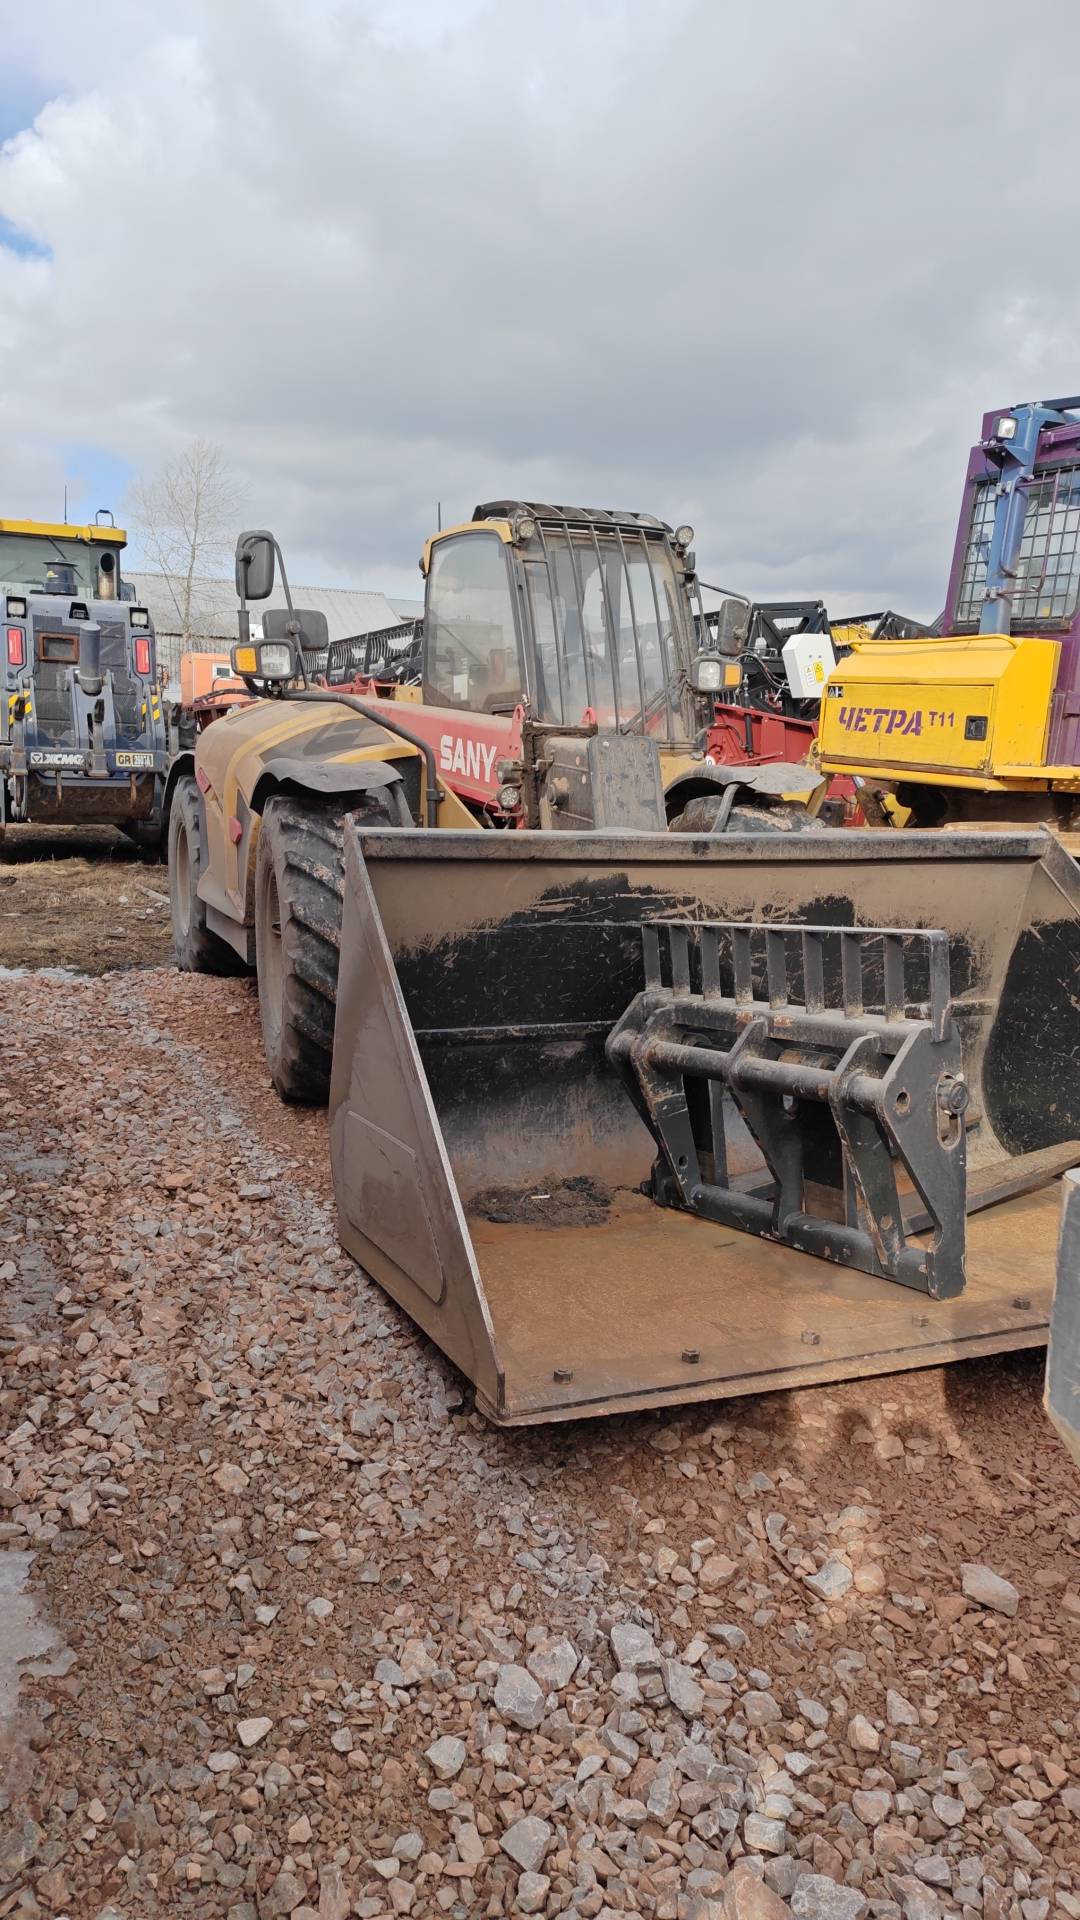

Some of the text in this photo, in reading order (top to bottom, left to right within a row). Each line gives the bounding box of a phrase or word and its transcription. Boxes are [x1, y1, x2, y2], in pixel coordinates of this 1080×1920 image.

[838, 706, 923, 737] ЧЕТРА
[43, 753, 85, 765] XCMG
[440, 734, 497, 783] SANY
